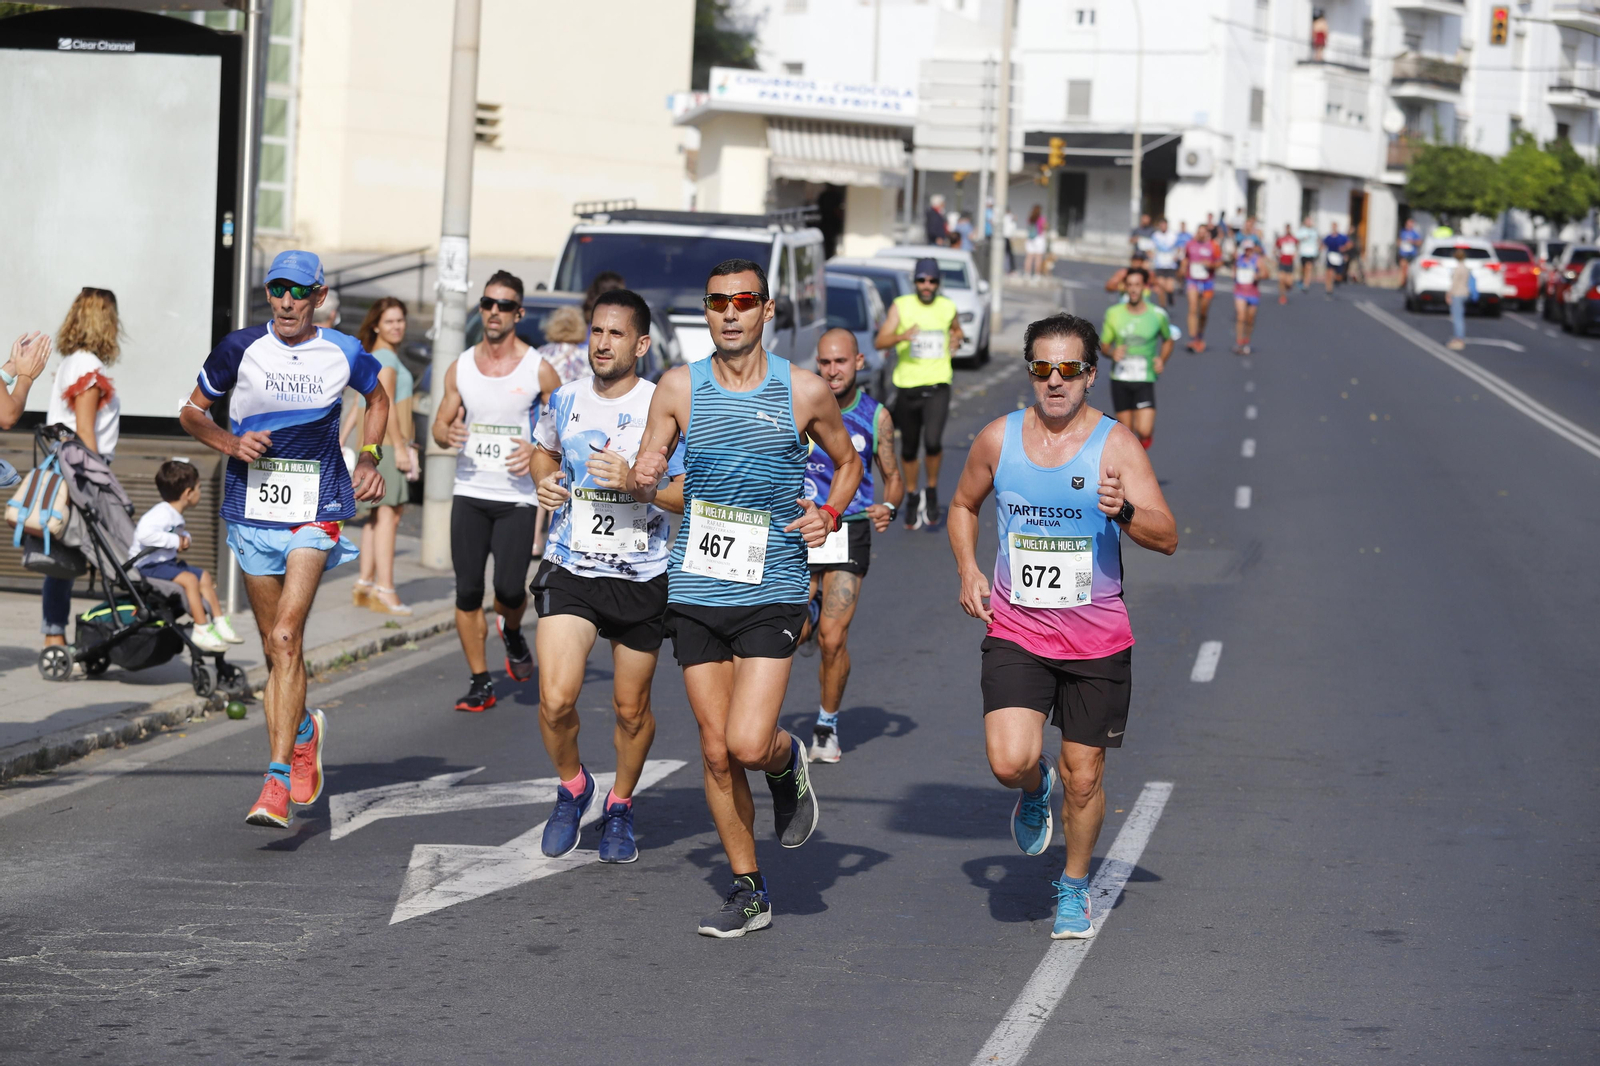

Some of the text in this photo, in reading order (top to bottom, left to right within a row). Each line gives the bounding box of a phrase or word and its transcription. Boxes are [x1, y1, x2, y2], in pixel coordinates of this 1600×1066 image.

[72, 39, 136, 52] Clear Channel
[735, 76, 817, 91] CHURROS
[758, 90, 902, 111] PATATAS FRITAS
[265, 371, 324, 384] RUNNERS LA
[265, 380, 324, 395] PALMERA
[475, 442, 501, 459] 449
[261, 461, 283, 471] VUELTA
[284, 463, 290, 472] A
[290, 463, 315, 473] HUELVA
[806, 462, 825, 473] CC
[258, 483, 292, 505] 530
[586, 491, 611, 502] VUELTA
[612, 493, 617, 502] A
[696, 504, 763, 525] 34 VUELTA A HUELVA
[1007, 503, 1083, 520] TARTESSOS
[591, 513, 615, 536] 22
[706, 519, 726, 528] RAFAEL
[1026, 518, 1061, 527] HUELVA
[699, 532, 736, 560] 467
[1022, 538, 1048, 551] VUELTA
[1050, 540, 1056, 551] A
[1022, 564, 1061, 589] 672
